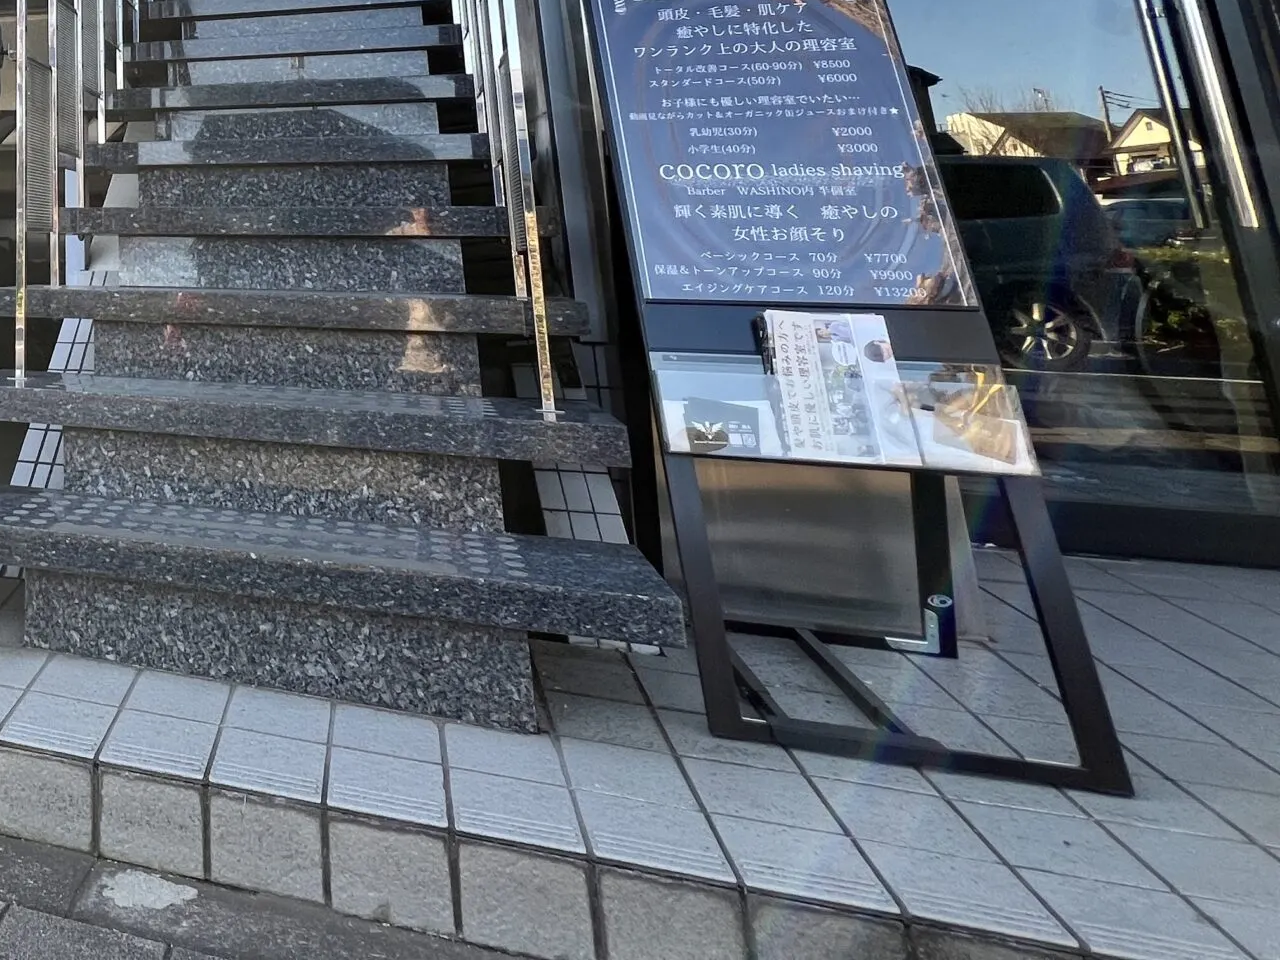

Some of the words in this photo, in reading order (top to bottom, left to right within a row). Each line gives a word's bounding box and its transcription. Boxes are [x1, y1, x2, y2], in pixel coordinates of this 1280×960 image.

[658, 2, 807, 22] 頭皮・毛髪・肌ケア
[676, 19, 813, 39] 癒やしに特化した
[633, 37, 858, 59] ワンランク上の大人の理容室
[813, 59, 851, 69] ¥8500
[818, 73, 858, 83] ¥6000
[832, 126, 872, 137] ¥2000
[688, 143, 756, 155] 小学生(40分)
[837, 143, 878, 154] ¥3000
[660, 162, 764, 181] cocoro
[771, 163, 826, 177] ladies
[832, 164, 905, 179] shaving
[687, 186, 725, 196] Barber
[674, 204, 798, 220] 輝く素肌に導く
[821, 204, 898, 220] 癒やしの
[733, 226, 845, 242] 女性お顔そり
[700, 251, 800, 262] ベーシックコース
[809, 252, 837, 263] 70分
[864, 253, 907, 264] ¥7700
[812, 269, 842, 280] 90分
[870, 270, 913, 281] ¥9900
[682, 284, 808, 296] エイジングケアコース
[819, 285, 854, 296] 120分
[874, 286, 926, 298] ¥13200
